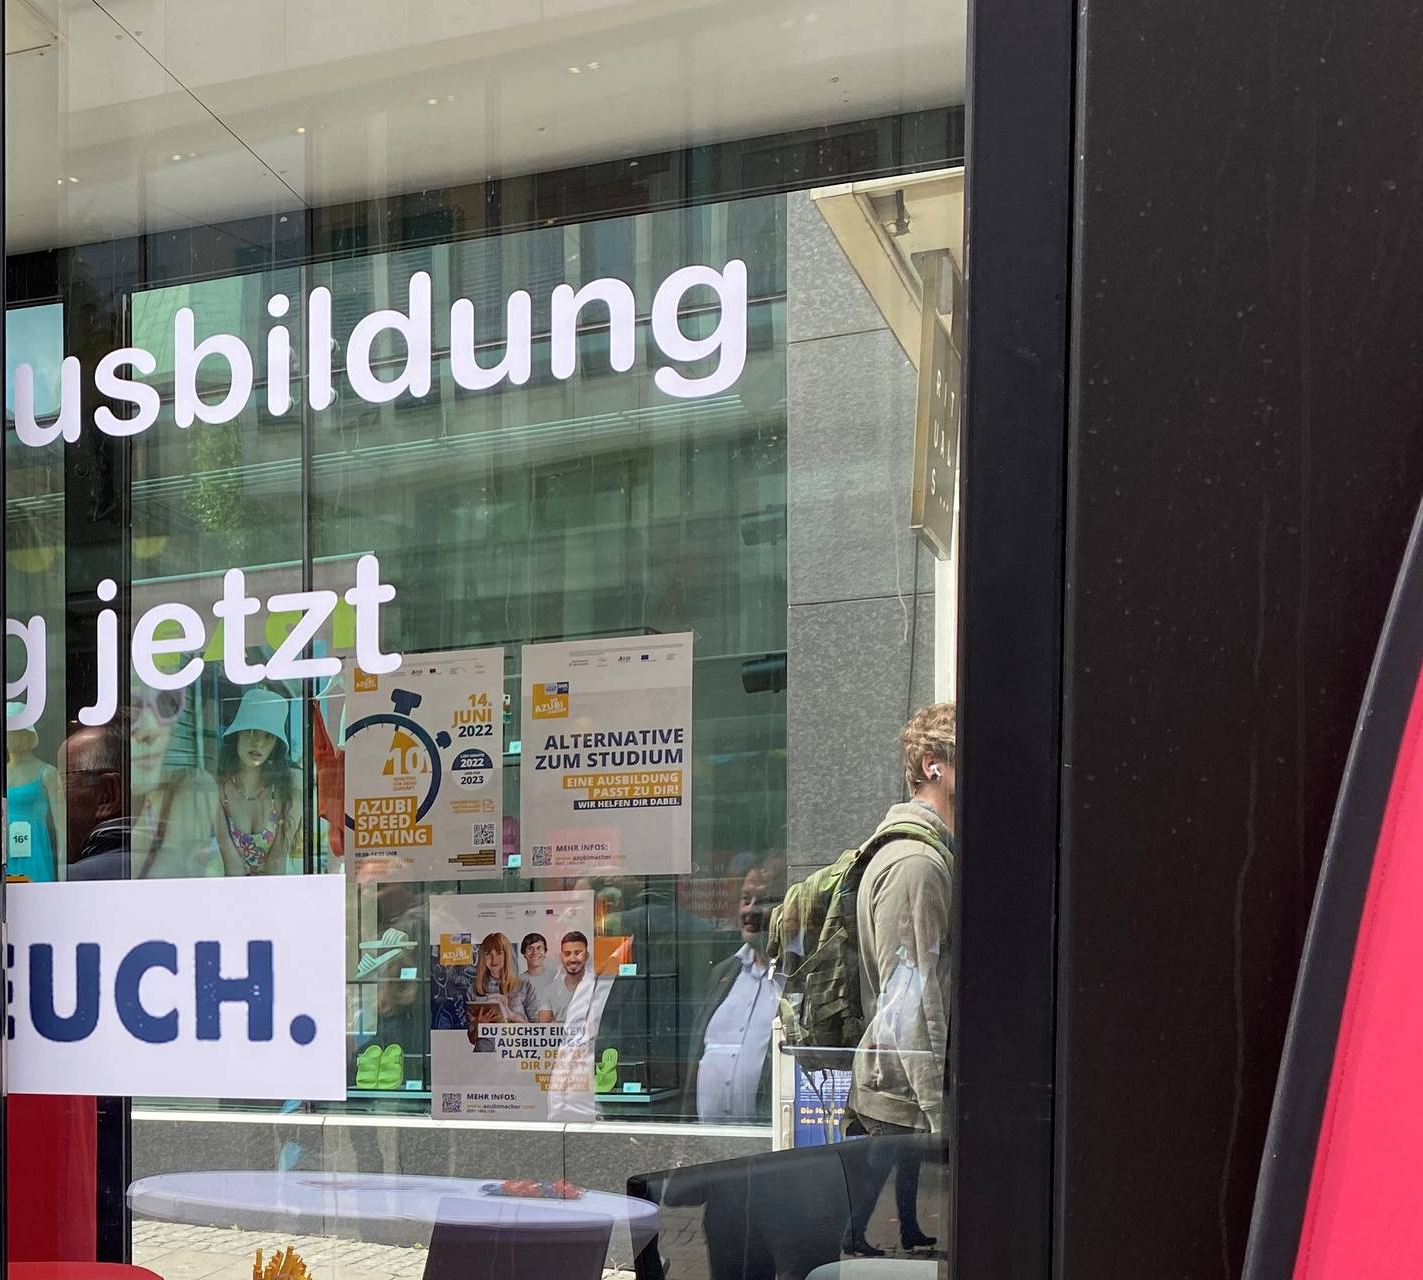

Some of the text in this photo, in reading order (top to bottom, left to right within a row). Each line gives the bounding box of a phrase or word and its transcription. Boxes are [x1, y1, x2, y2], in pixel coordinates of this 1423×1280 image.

[14, 259, 747, 448] usbildung
[78, 554, 402, 727] jetzt
[467, 693, 493, 707] 14.
[451, 708, 493, 728] JUNI
[458, 724, 493, 738] 2022
[544, 728, 684, 750] ALTERNATIVE
[389, 747, 425, 775] 10
[460, 758, 485, 769] 2022
[534, 749, 683, 770] ZUM STUDIUM
[460, 776, 484, 785] 2023
[567, 772, 679, 788] EINE AUSBILDUNG
[593, 785, 679, 798] PASST ZU DIR!
[357, 799, 412, 815] AZUBI
[578, 798, 680, 809] WIR HELFEN DIR DABEI.
[358, 815, 411, 831] SPEED
[358, 829, 427, 846] DATING
[580, 844, 609, 852] INFOS:
[6, 938, 317, 1046] UCH.
[481, 1026, 498, 1036] DU
[501, 1026, 545, 1036] SUCHST
[501, 1050, 541, 1060] PLATZ,
[520, 1061, 541, 1070] DIR
[491, 1093, 517, 1101] INFOS:
